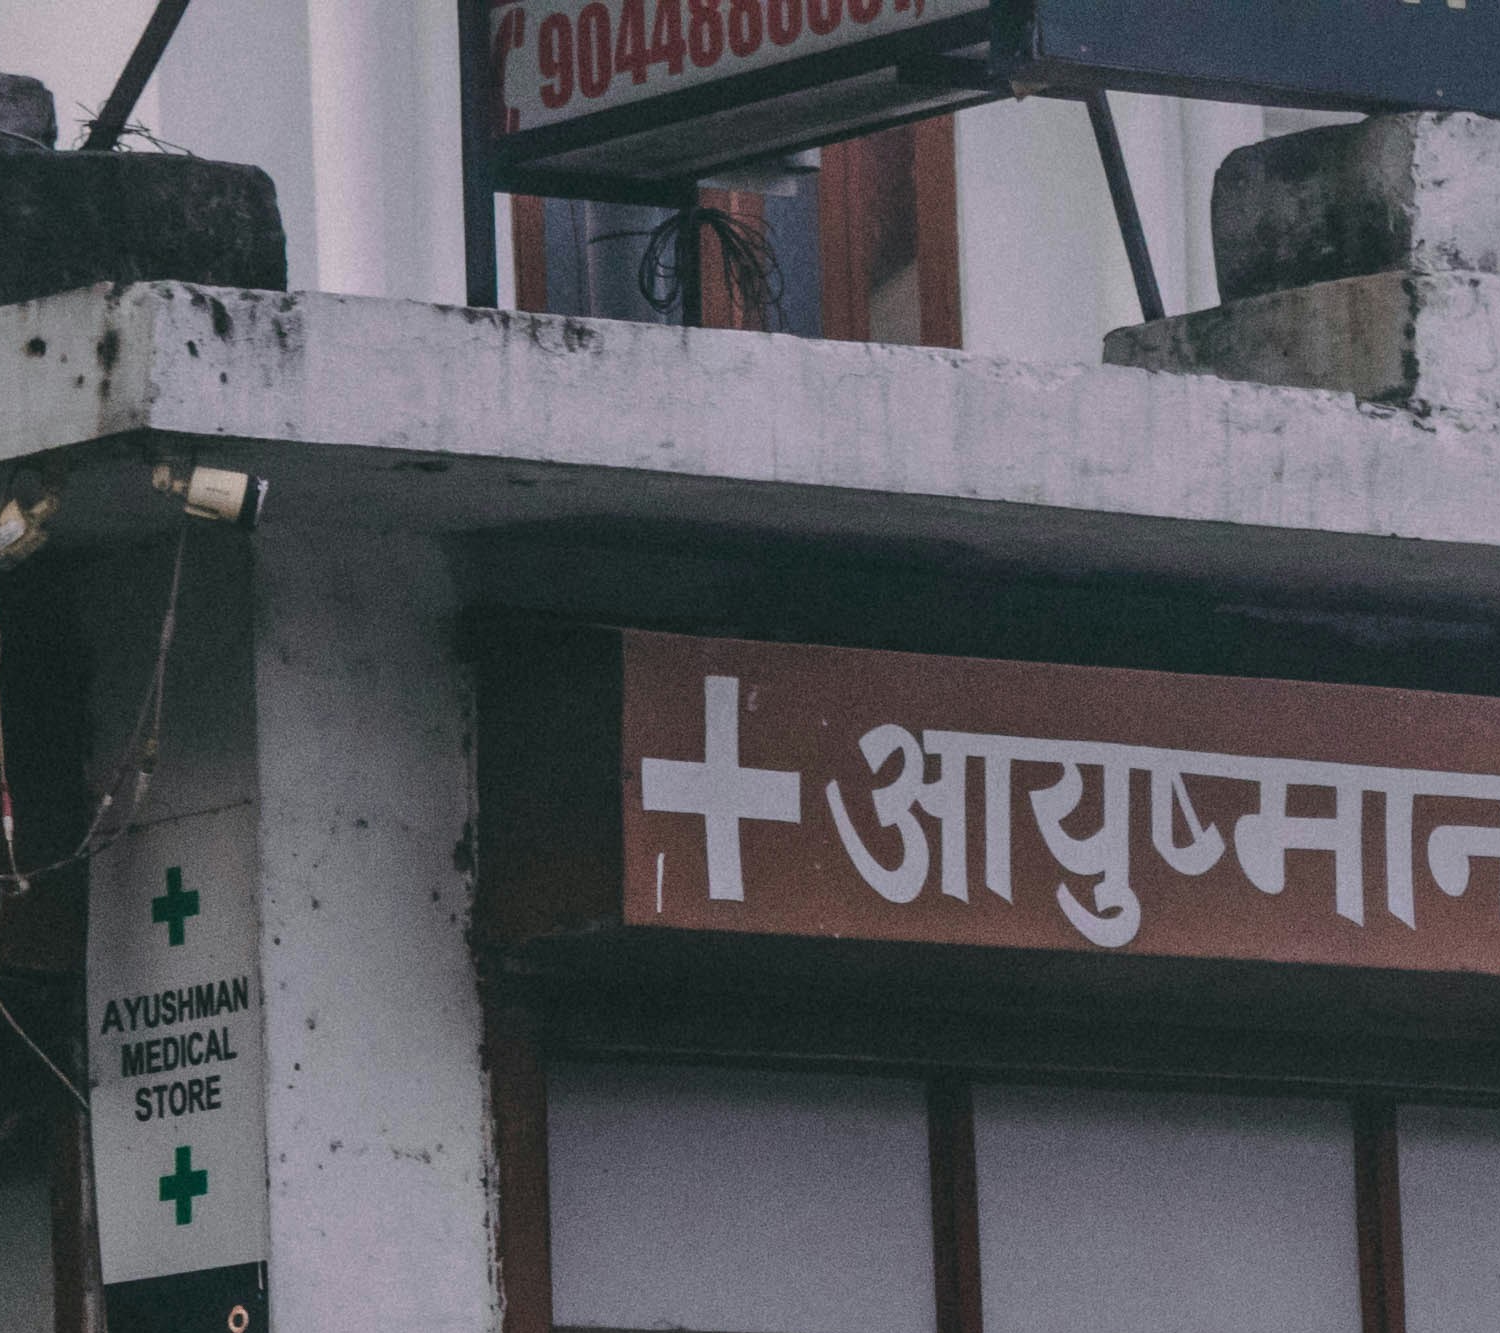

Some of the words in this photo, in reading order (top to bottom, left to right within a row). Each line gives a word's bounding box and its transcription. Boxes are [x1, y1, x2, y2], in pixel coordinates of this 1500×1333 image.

[102, 976, 249, 1035] AYUSHMAN
[121, 1027, 238, 1078] MEDICAL
[135, 1075, 222, 1122] STORE
